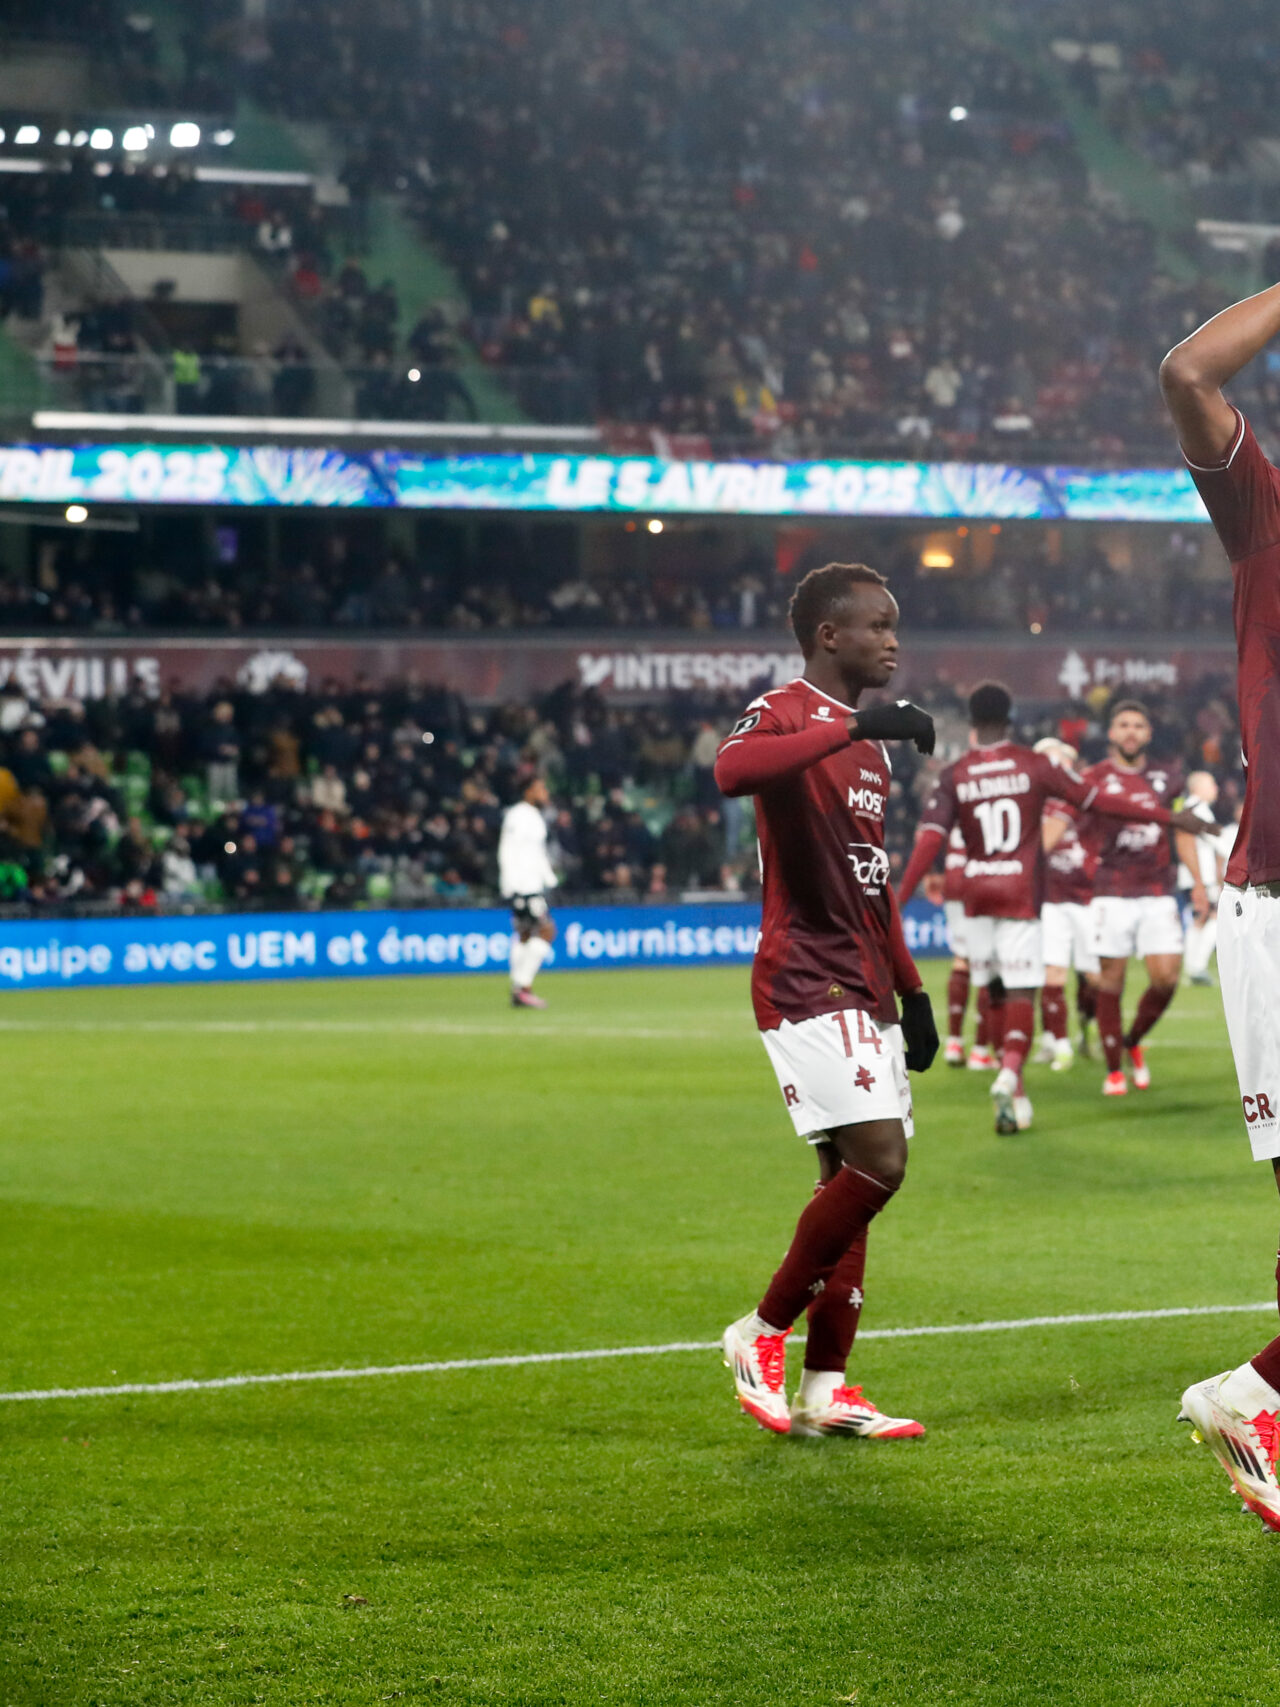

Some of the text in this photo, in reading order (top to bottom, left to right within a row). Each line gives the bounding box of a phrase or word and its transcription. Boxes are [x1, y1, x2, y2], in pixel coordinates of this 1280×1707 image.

[92, 450, 229, 499] 2025
[547, 460, 613, 507] LE
[650, 463, 797, 512] AVRIL
[800, 466, 922, 513] 2025
[613, 653, 804, 691] INTERSPOR
[973, 797, 1021, 856] 10
[123, 940, 217, 972] avec
[227, 930, 317, 969] UEM
[326, 930, 368, 966] et
[377, 925, 515, 968] énerge
[566, 920, 763, 960] fournisseu
